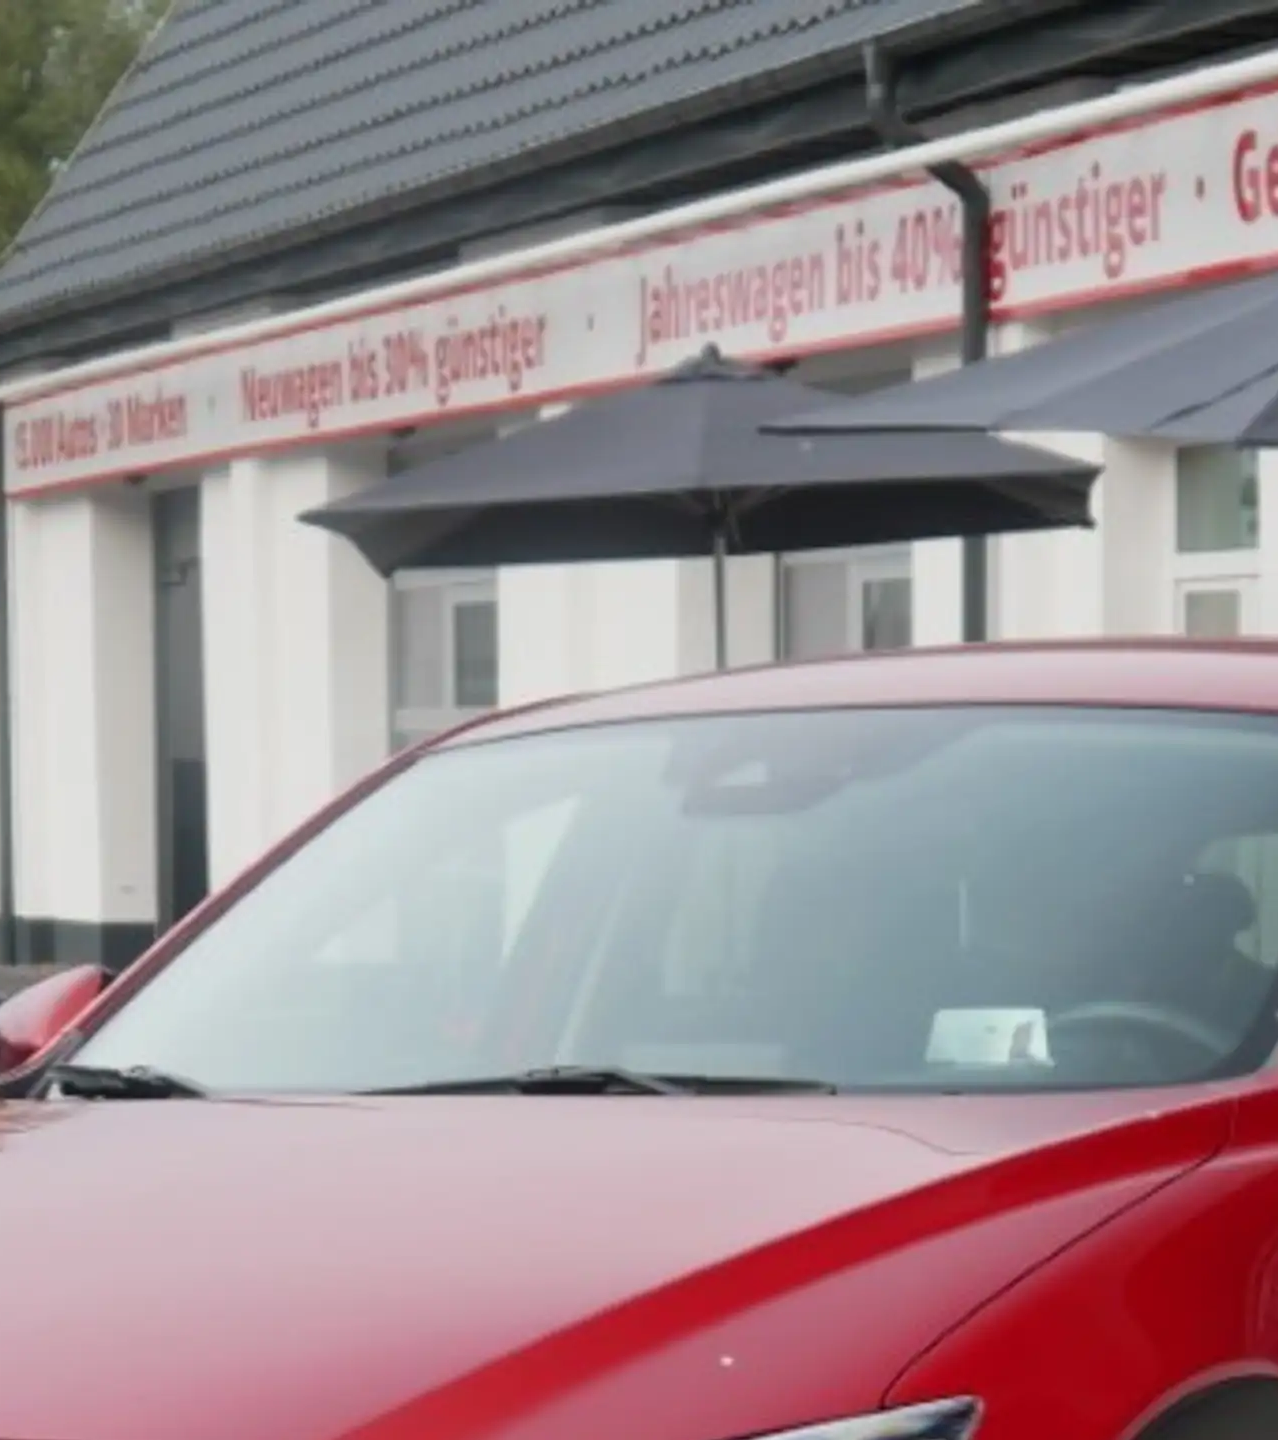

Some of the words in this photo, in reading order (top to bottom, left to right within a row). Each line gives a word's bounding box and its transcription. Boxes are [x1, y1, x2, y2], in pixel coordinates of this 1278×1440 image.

[127, 388, 187, 446] Marken
[239, 361, 343, 428] Neuwagen
[348, 336, 379, 400] bis
[383, 329, 429, 397] 30%
[435, 303, 547, 406] günstiger
[635, 249, 825, 367] Jahreswagen
[836, 220, 882, 305] bis
[890, 204, 964, 296] 40%
[987, 160, 1165, 300] günstiger
